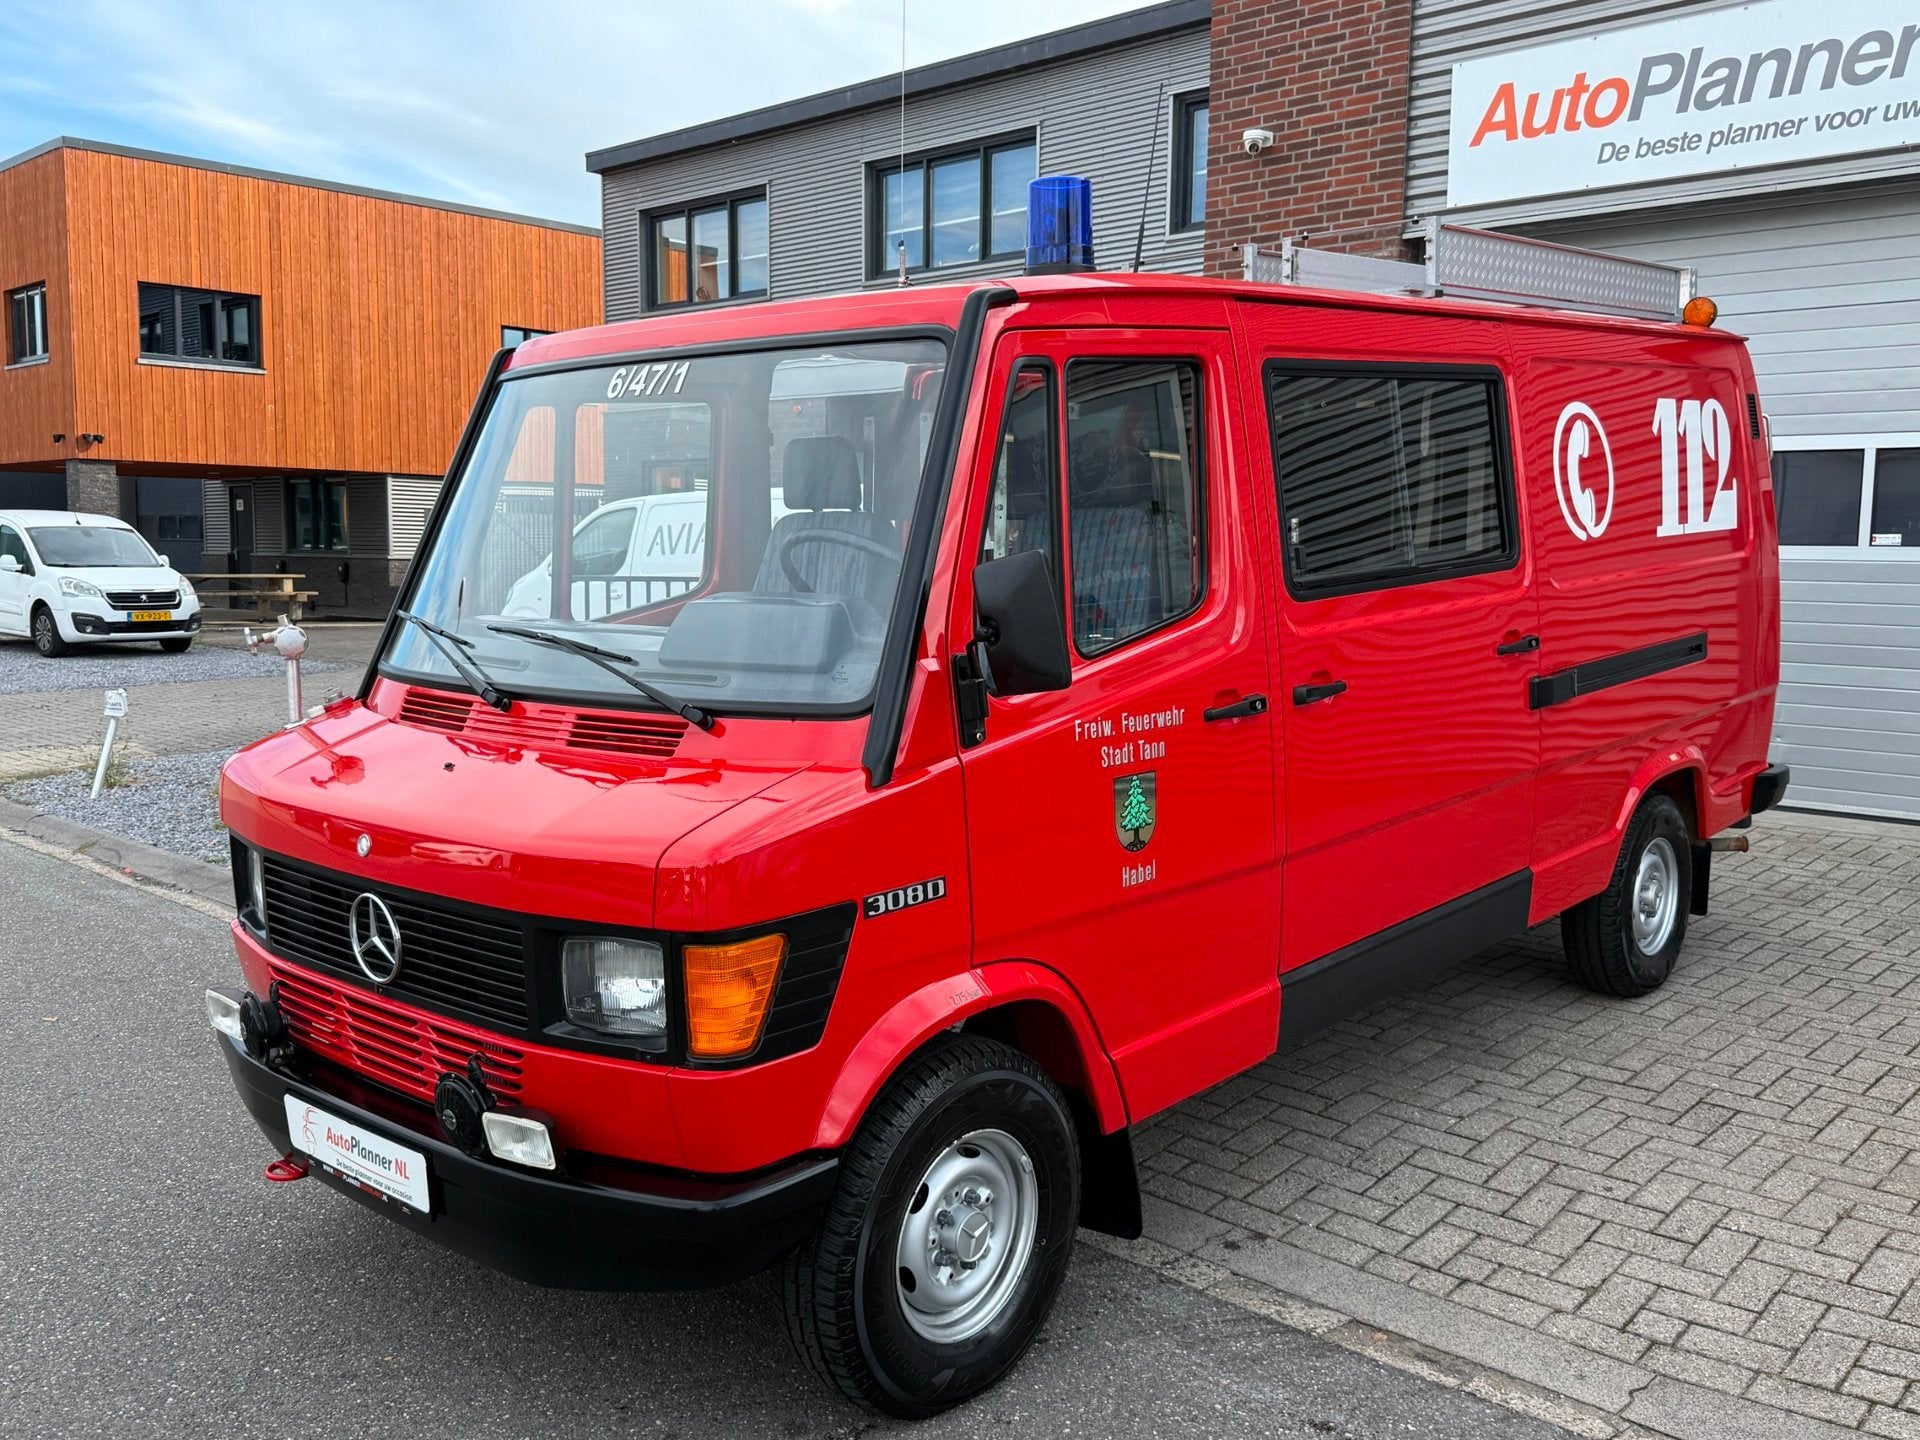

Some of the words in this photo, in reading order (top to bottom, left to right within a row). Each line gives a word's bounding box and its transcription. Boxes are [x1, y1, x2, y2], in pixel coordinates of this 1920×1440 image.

[1469, 24, 1920, 147] AutoPlanner
[1597, 142, 1630, 165] De
[1634, 131, 1702, 159] beste
[1705, 117, 1809, 155] planner
[1813, 105, 1878, 133] voor
[1882, 99, 1920, 122] uw
[606, 361, 690, 400] 6/47/1
[1651, 398, 1738, 537] 112
[1074, 717, 1116, 742] Freiw.
[1121, 705, 1186, 735] Feuerwehr
[1101, 743, 1135, 768] Stadt
[1138, 740, 1166, 761] Tann
[1122, 859, 1157, 888] Habel
[326, 1127, 393, 1172] AutoPlanner
[394, 1158, 410, 1180] NL
[335, 1158, 343, 1168] De
[342, 1161, 355, 1174] beste
[354, 1169, 373, 1183] planner
[373, 1177, 384, 1189] voor
[384, 1182, 392, 1192] uw
[391, 1186, 414, 1202] occasion
